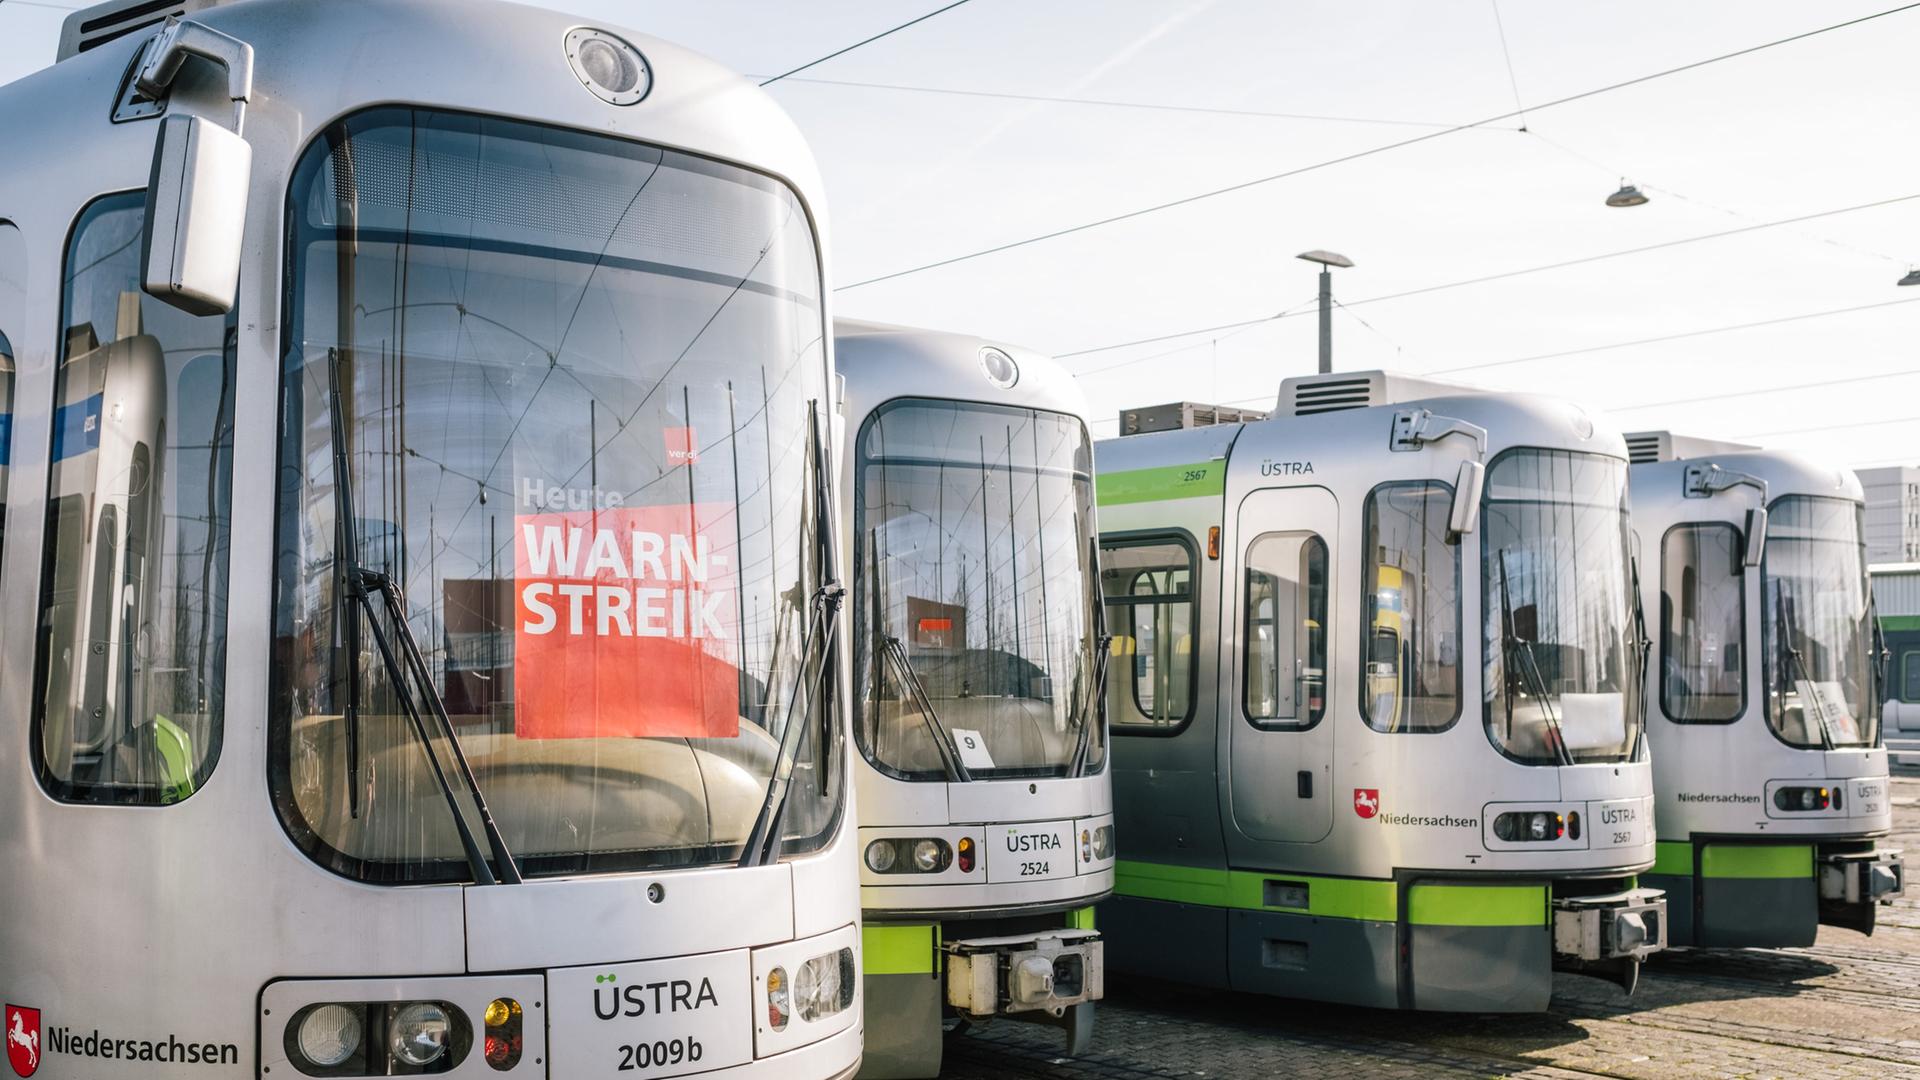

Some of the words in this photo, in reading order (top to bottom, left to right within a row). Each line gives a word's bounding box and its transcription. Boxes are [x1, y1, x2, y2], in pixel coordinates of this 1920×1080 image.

[1183, 470, 1208, 482] 2567
[1261, 459, 1314, 477] ÜSTRA
[522, 477, 625, 510] Heute
[522, 523, 729, 583] WARN-
[521, 582, 729, 640] STREIK
[963, 736, 976, 750] 9
[1678, 792, 1761, 804] Niedersachsen
[1379, 812, 1478, 828] Niedersachsen
[1601, 804, 1637, 824] ÜSTRA
[1006, 828, 1062, 852] ÜSTRA
[1020, 862, 1050, 876] 2524
[593, 973, 719, 1021] ÜSTRA
[48, 1026, 239, 1065] Niedersachsen
